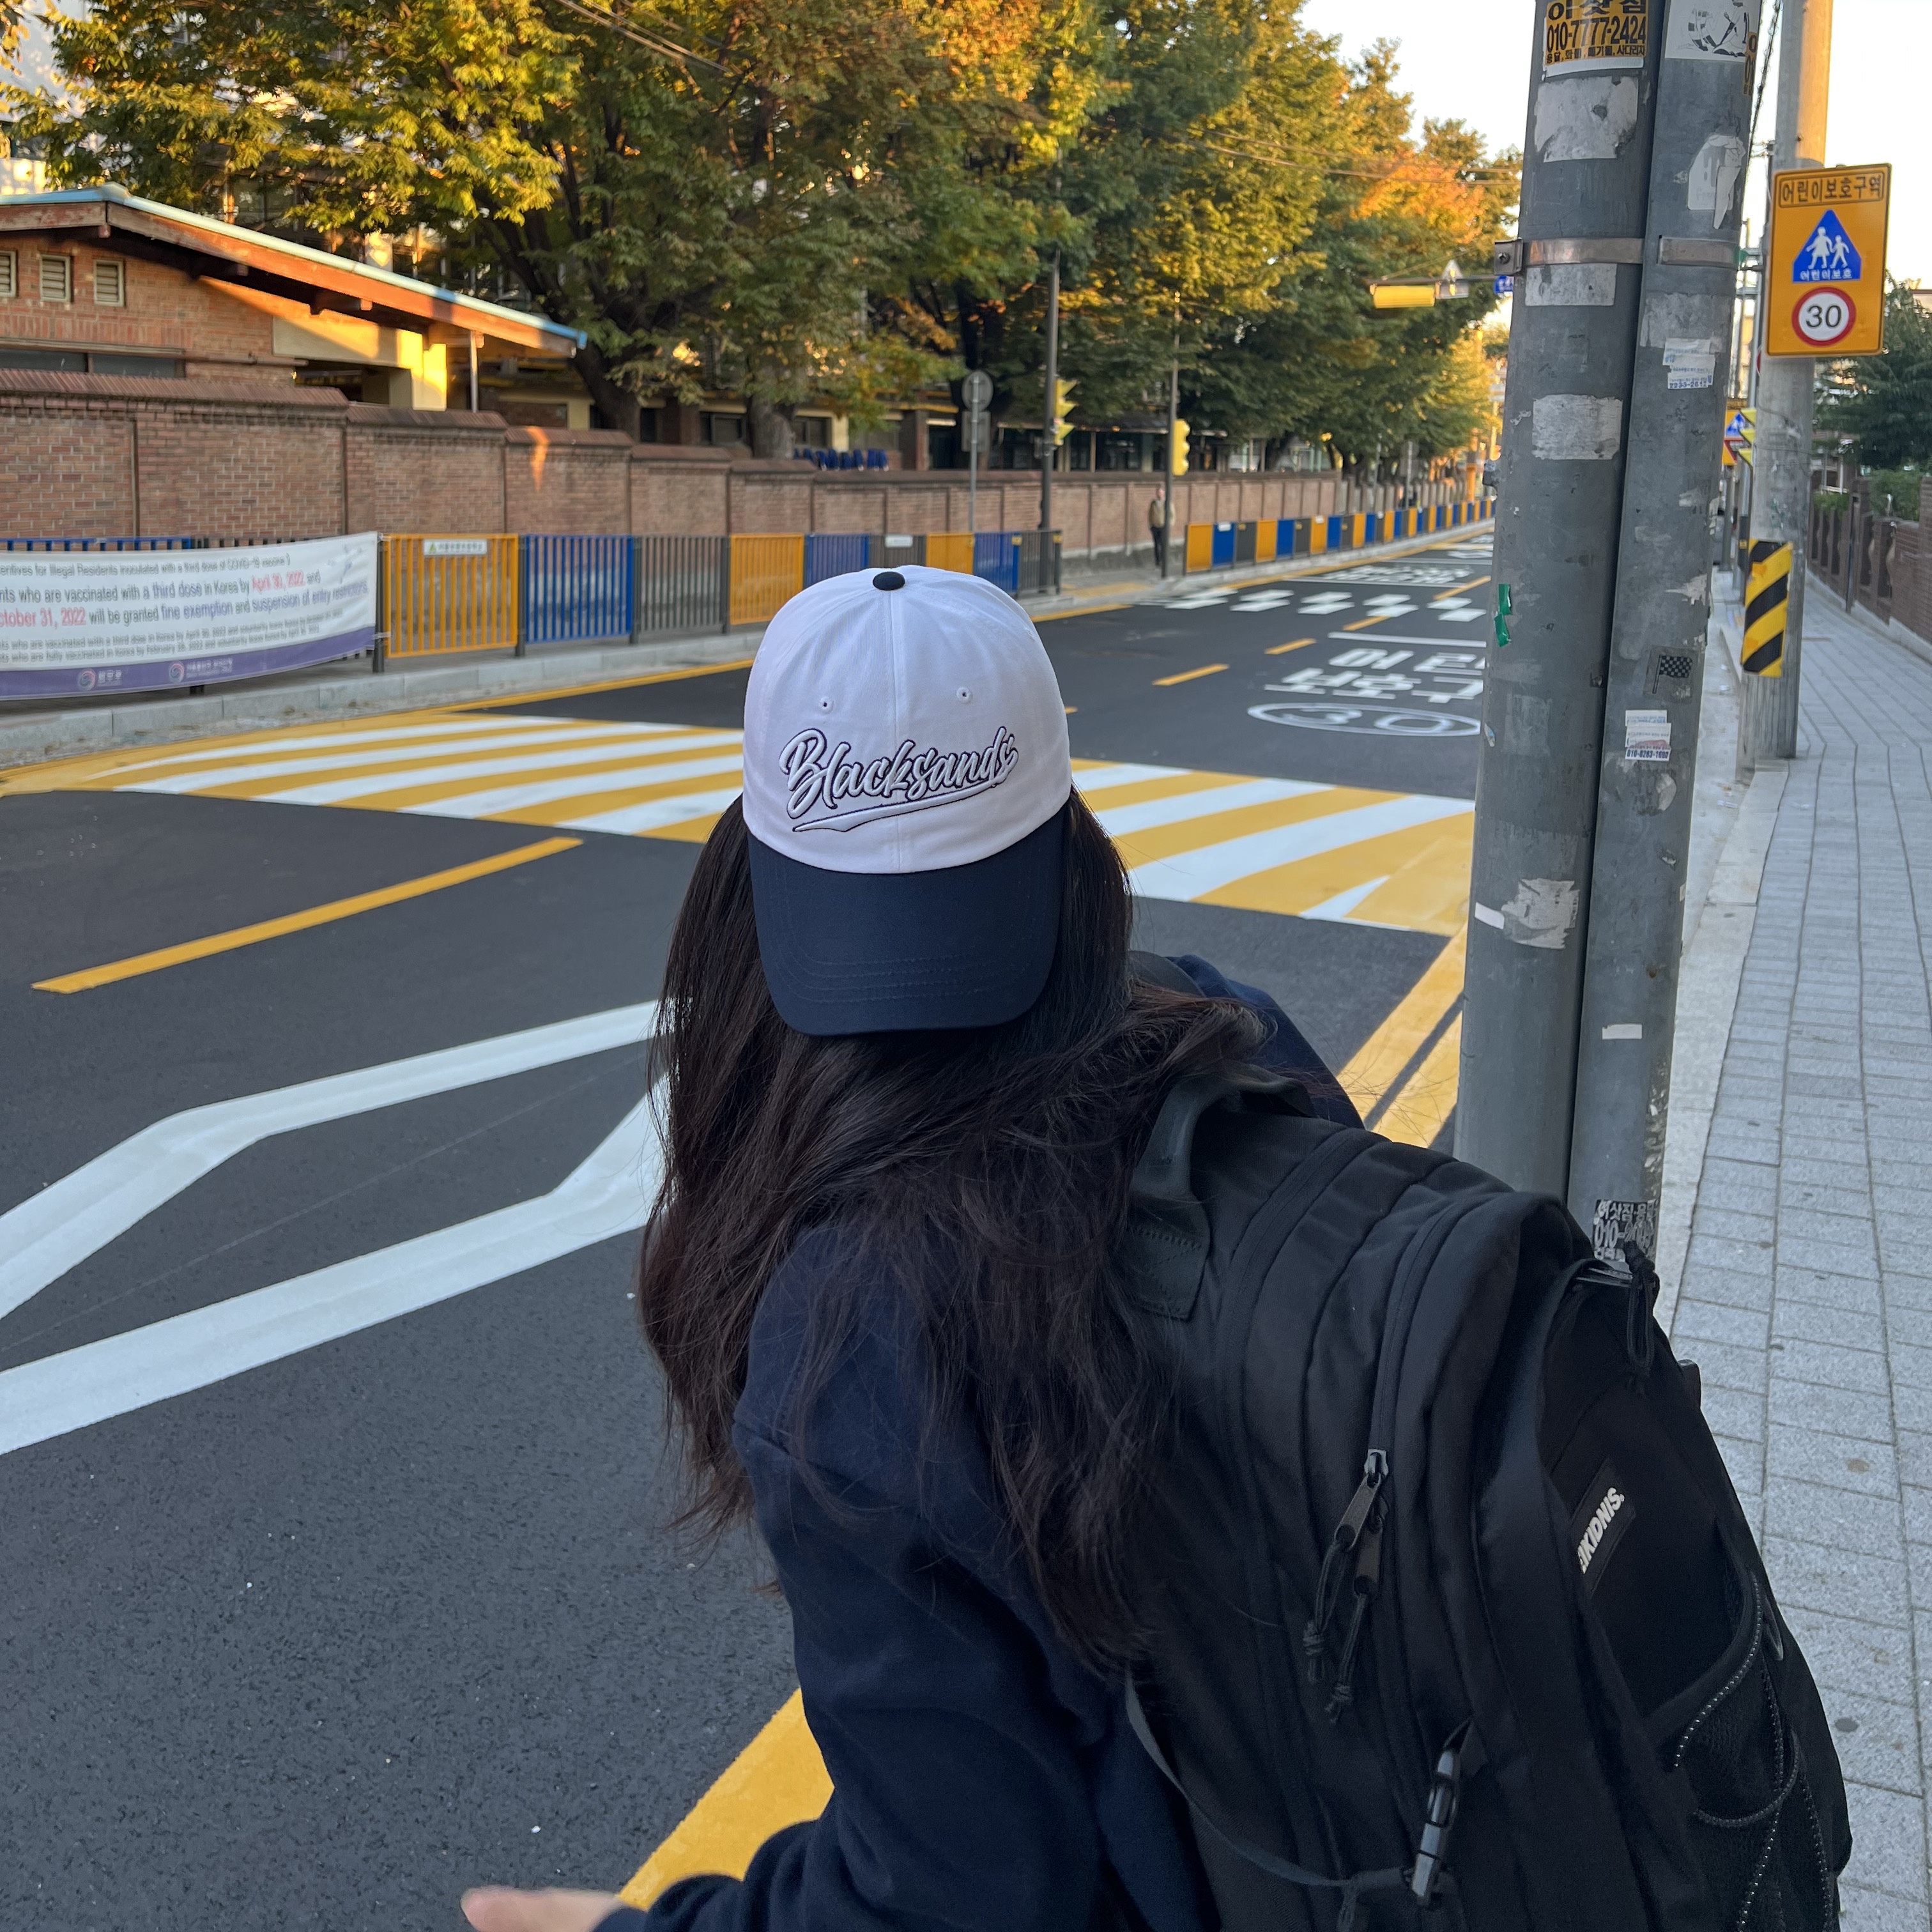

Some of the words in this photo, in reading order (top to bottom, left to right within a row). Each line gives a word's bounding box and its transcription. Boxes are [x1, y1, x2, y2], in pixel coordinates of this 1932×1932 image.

[1547, 15, 1646, 53] 010-7777-2424
[1805, 305, 1842, 328] 30
[19, 586, 41, 603] who
[45, 588, 61, 603] are
[65, 585, 118, 602] vaccinated
[121, 583, 141, 601] with
[143, 586, 150, 600] a
[152, 580, 176, 599] third
[178, 579, 203, 598] dose
[204, 581, 213, 595] in
[214, 579, 238, 595] Korea
[240, 578, 250, 596] by
[252, 574, 271, 594] April
[307, 569, 321, 585] and
[35, 563, 47, 576] for
[49, 563, 75, 579] Illegal
[77, 562, 118, 576] Residents
[162, 562, 176, 574] with
[40, 608, 58, 629] 31,
[61, 606, 87, 626] 2022
[89, 608, 105, 625] will
[108, 608, 121, 624] be
[123, 605, 159, 627] granted
[161, 603, 180, 622] fine
[183, 599, 233, 620] exemption
[235, 599, 250, 614] and
[252, 591, 300, 614] suspension
[1282, 707, 1455, 733] 30
[779, 726, 1019, 819] Blacksands
